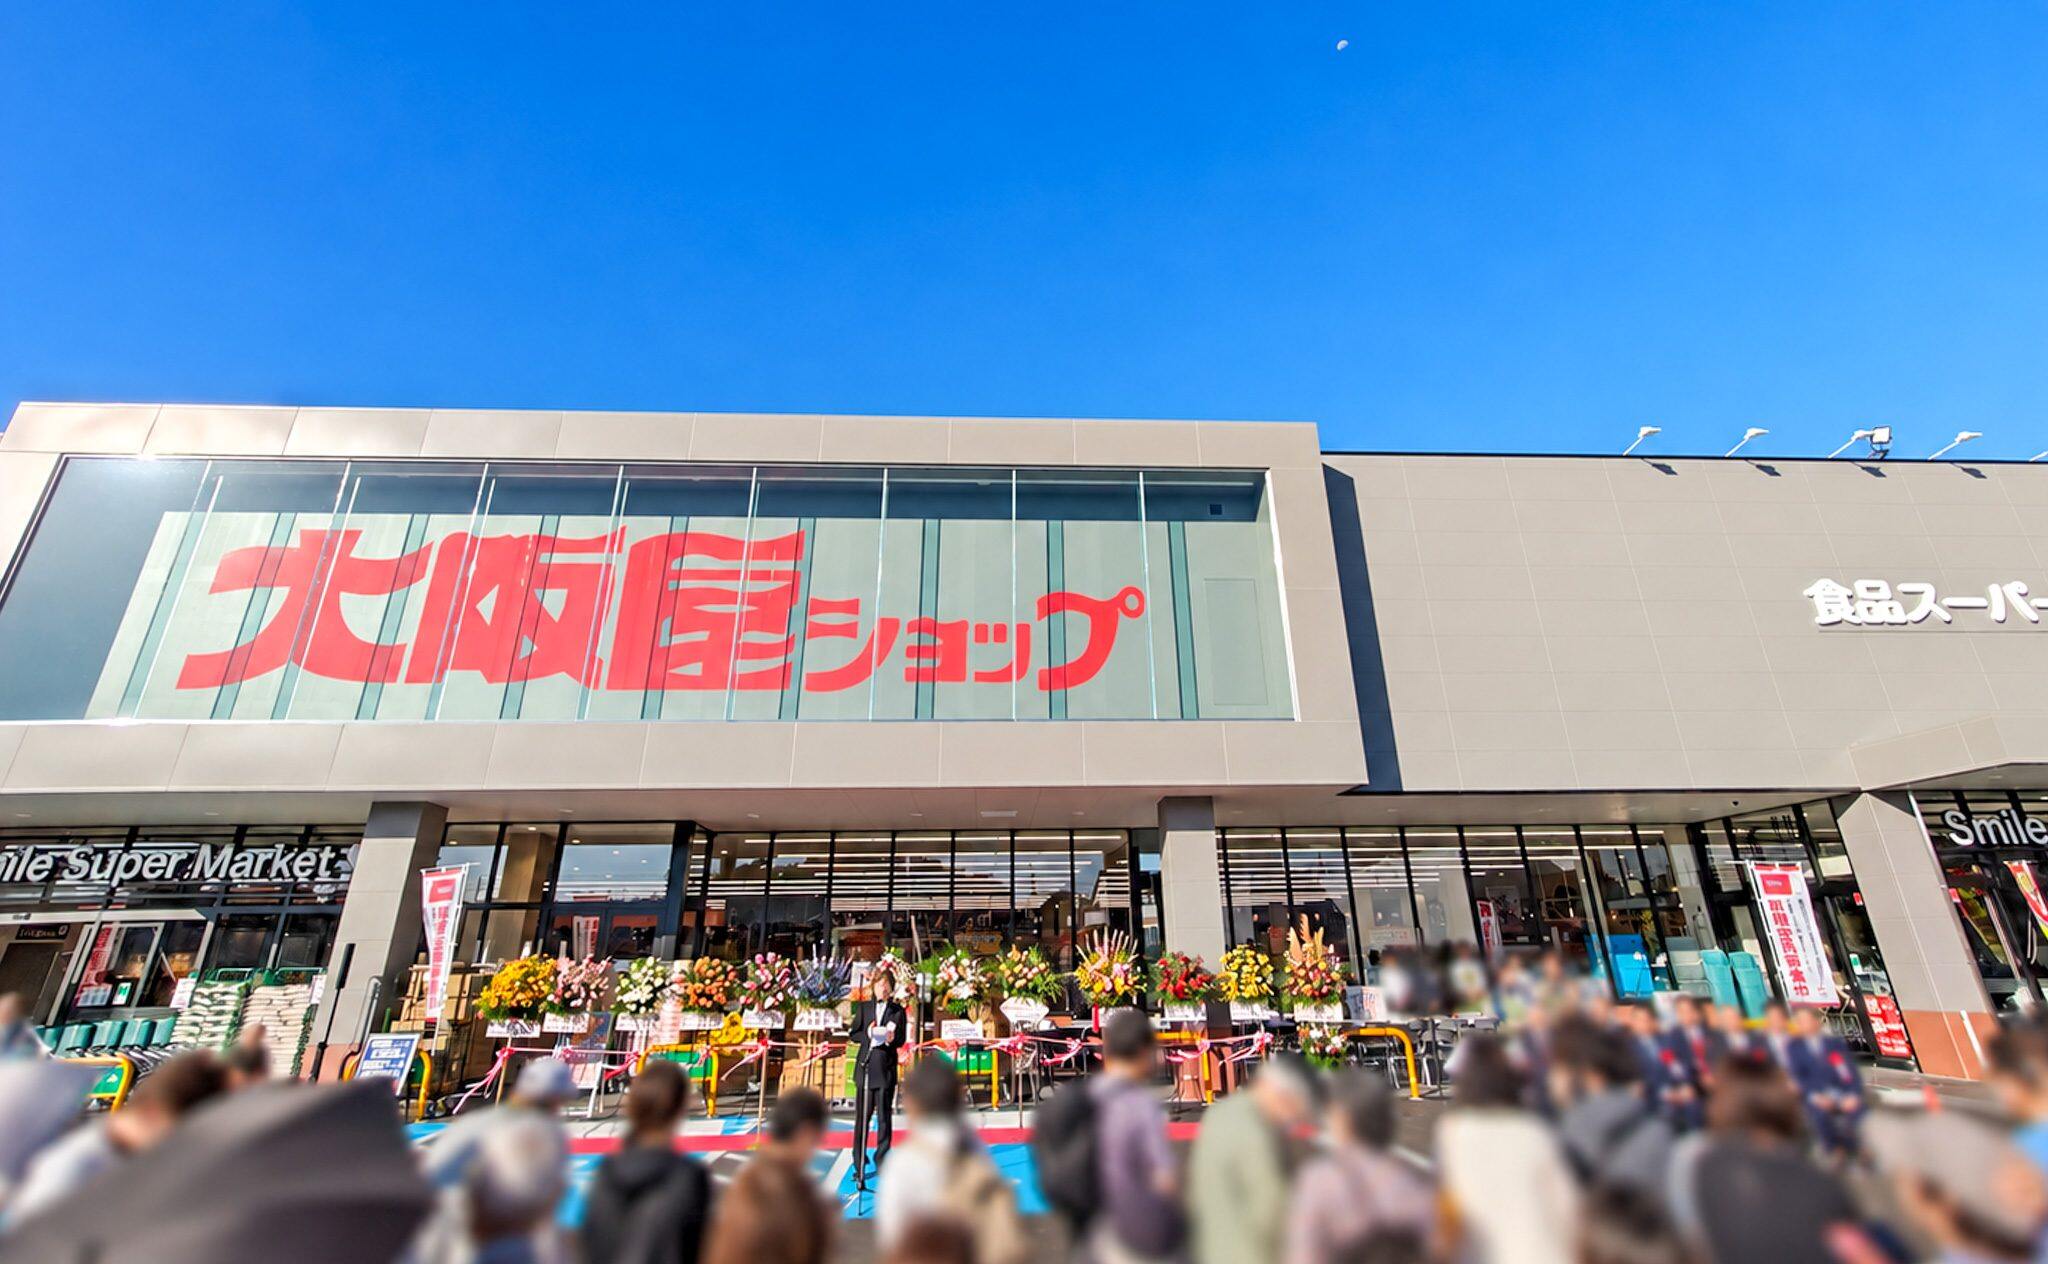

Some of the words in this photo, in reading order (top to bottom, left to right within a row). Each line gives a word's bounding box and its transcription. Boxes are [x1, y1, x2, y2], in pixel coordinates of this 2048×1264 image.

[178, 527, 1146, 692] 大阪屋ショップ
[1944, 809, 2048, 846] Smile
[62, 845, 189, 887] Super
[190, 842, 339, 881] Market
